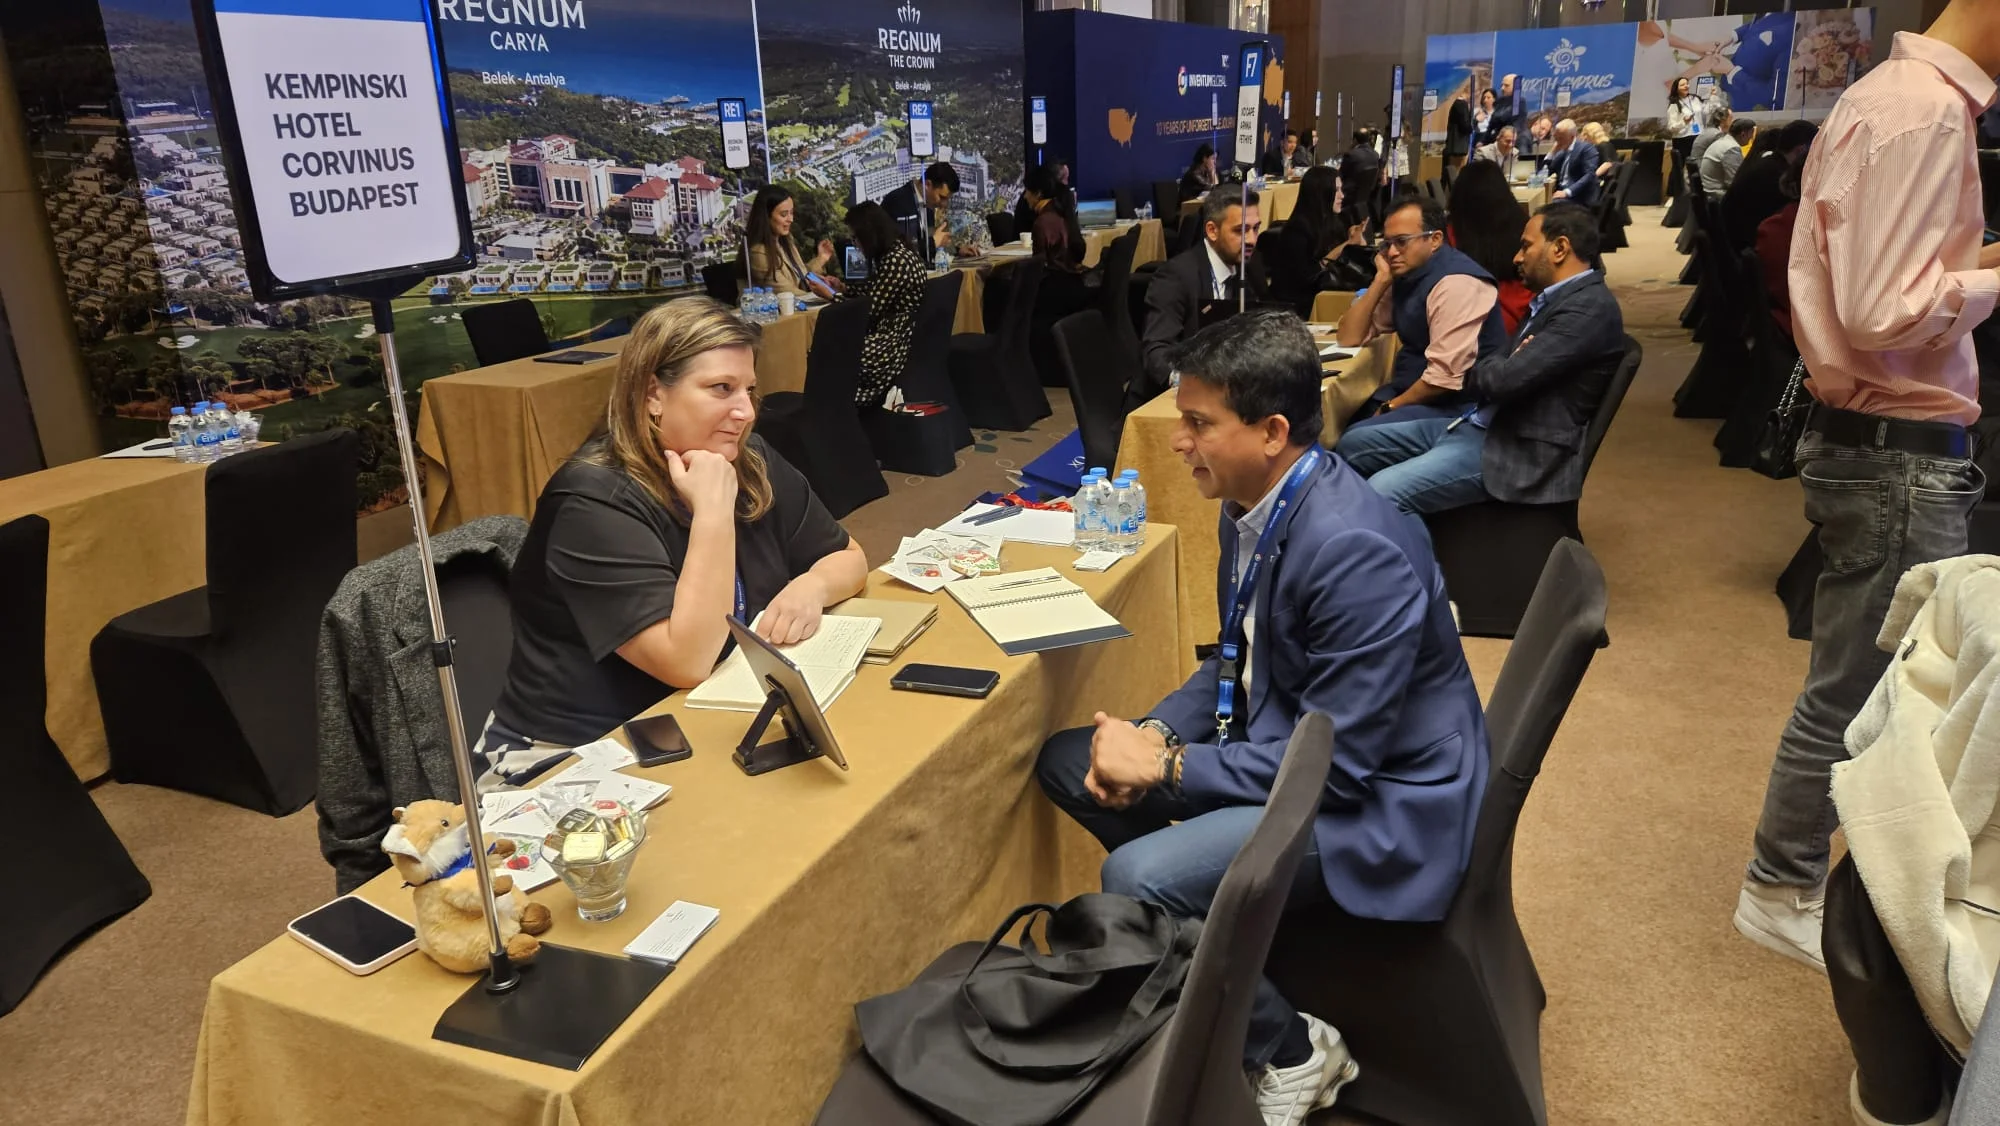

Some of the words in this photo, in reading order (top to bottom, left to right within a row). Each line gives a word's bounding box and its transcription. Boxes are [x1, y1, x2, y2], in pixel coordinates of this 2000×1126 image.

[438, 0, 587, 29] REGNUM
[490, 30, 550, 52] CARYA
[877, 27, 942, 54] REGNUM
[888, 54, 904, 68] THE
[906, 55, 935, 69] CROWN
[1245, 52, 1258, 78] F7
[265, 73, 408, 100] KEMPINSKI
[481, 71, 517, 86] Belek
[524, 71, 566, 89] Antalya
[895, 81, 910, 91] Belek
[723, 102, 741, 118] RE1
[911, 103, 928, 116] RE2
[273, 112, 362, 139] HOTEL
[282, 146, 415, 179] CORVINUS
[289, 182, 419, 217] BUDAPEST
